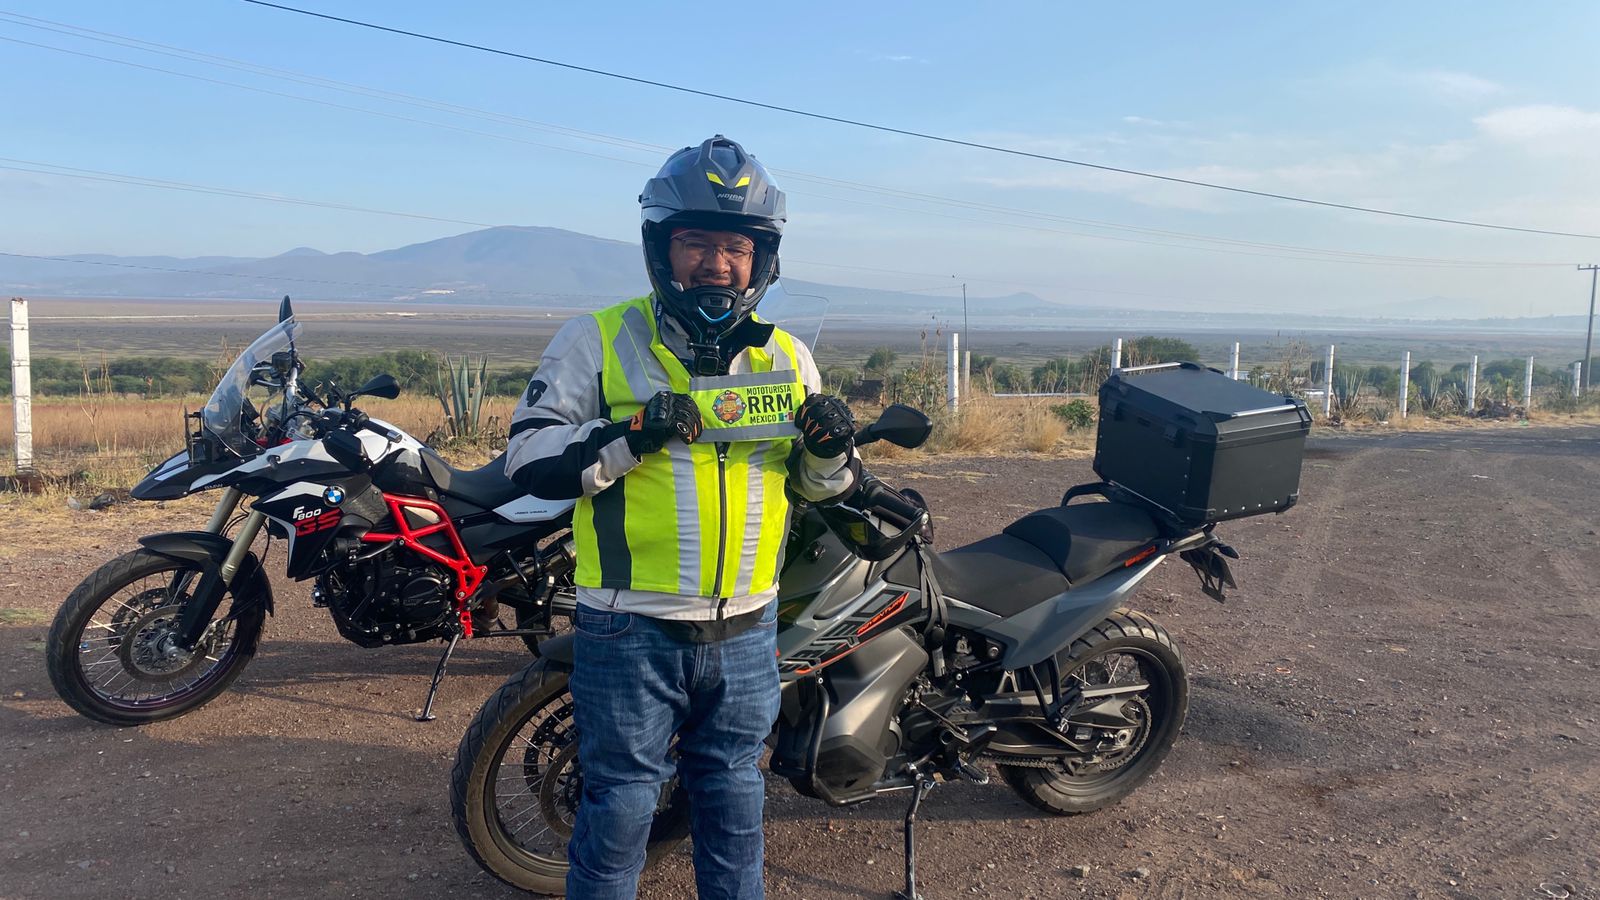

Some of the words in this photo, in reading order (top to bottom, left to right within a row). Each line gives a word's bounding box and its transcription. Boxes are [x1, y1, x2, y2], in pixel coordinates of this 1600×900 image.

[746, 385, 791, 395] MOTOTURISTA
[748, 393, 793, 414] RRM
[293, 508, 342, 536] GS
